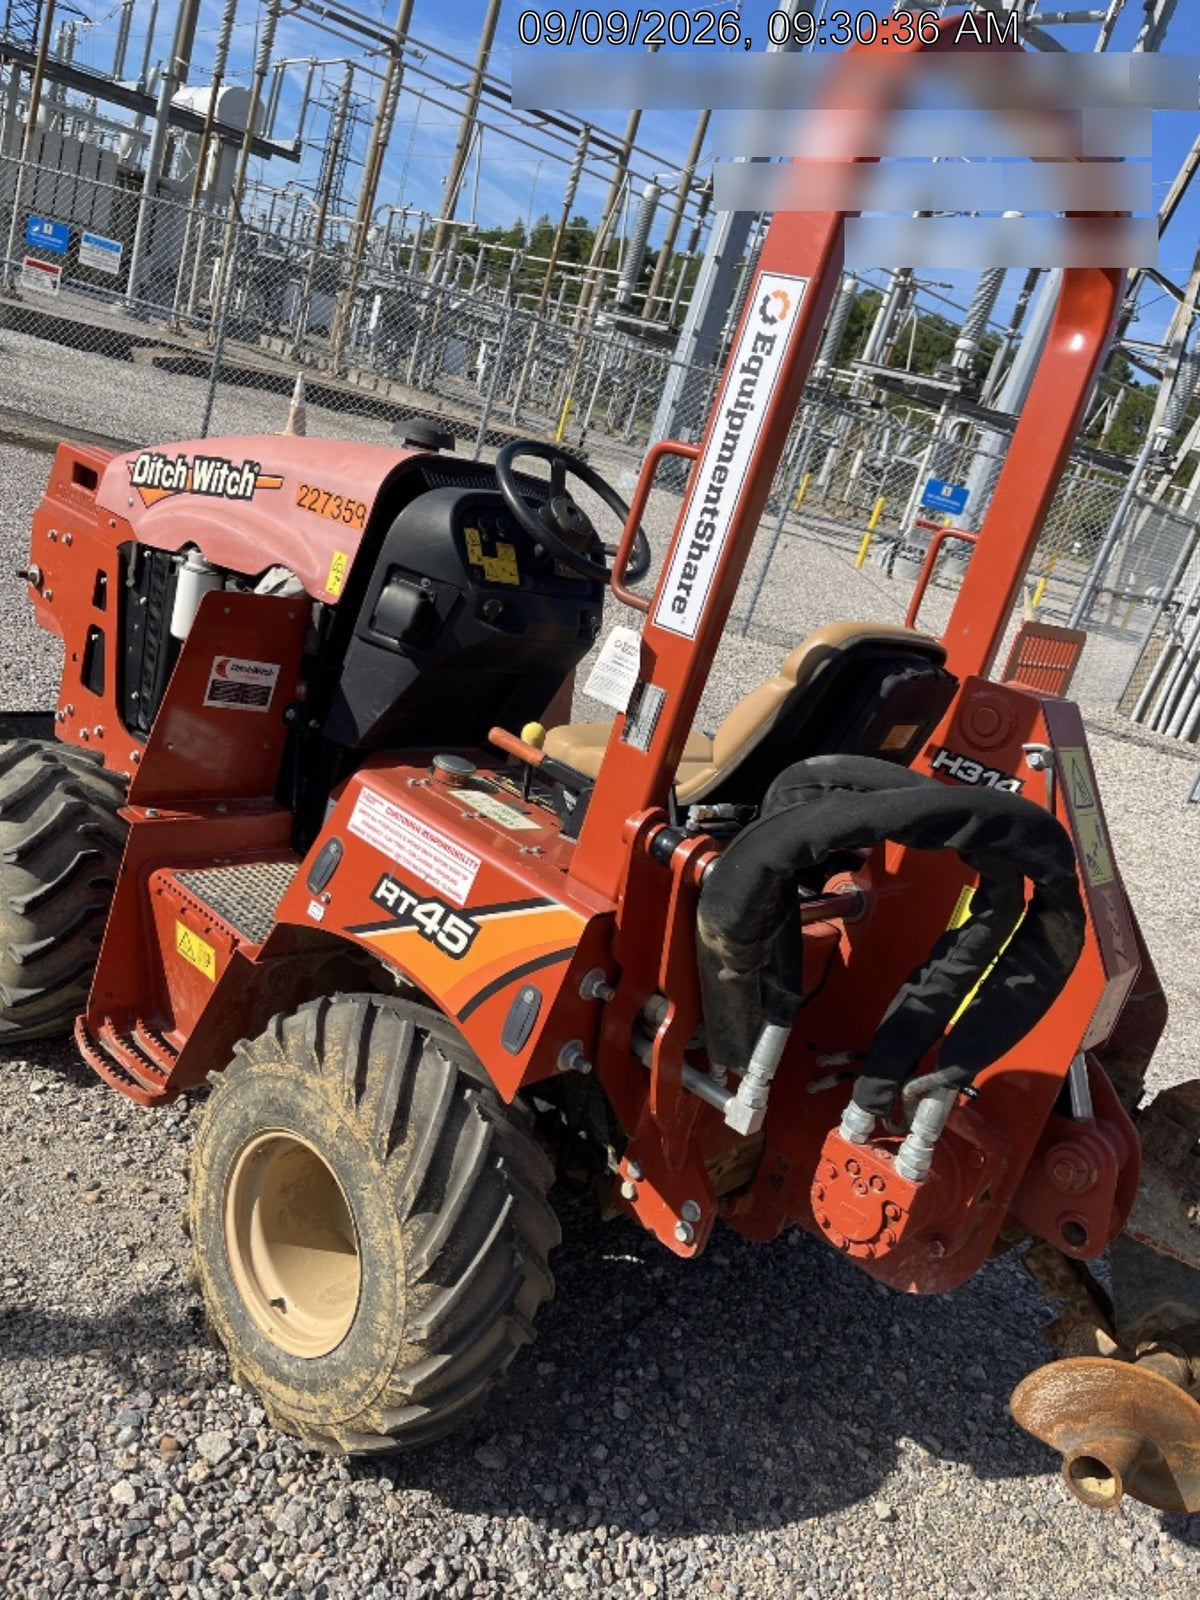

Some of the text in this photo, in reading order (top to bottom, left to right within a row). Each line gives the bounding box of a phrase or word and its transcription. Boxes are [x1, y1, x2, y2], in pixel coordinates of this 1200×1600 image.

[131, 453, 257, 498] Ditch Witch
[670, 333, 777, 615] EquipmentShare
[297, 484, 368, 527] 227359
[932, 749, 1022, 793] H314
[374, 878, 476, 954] RT45
